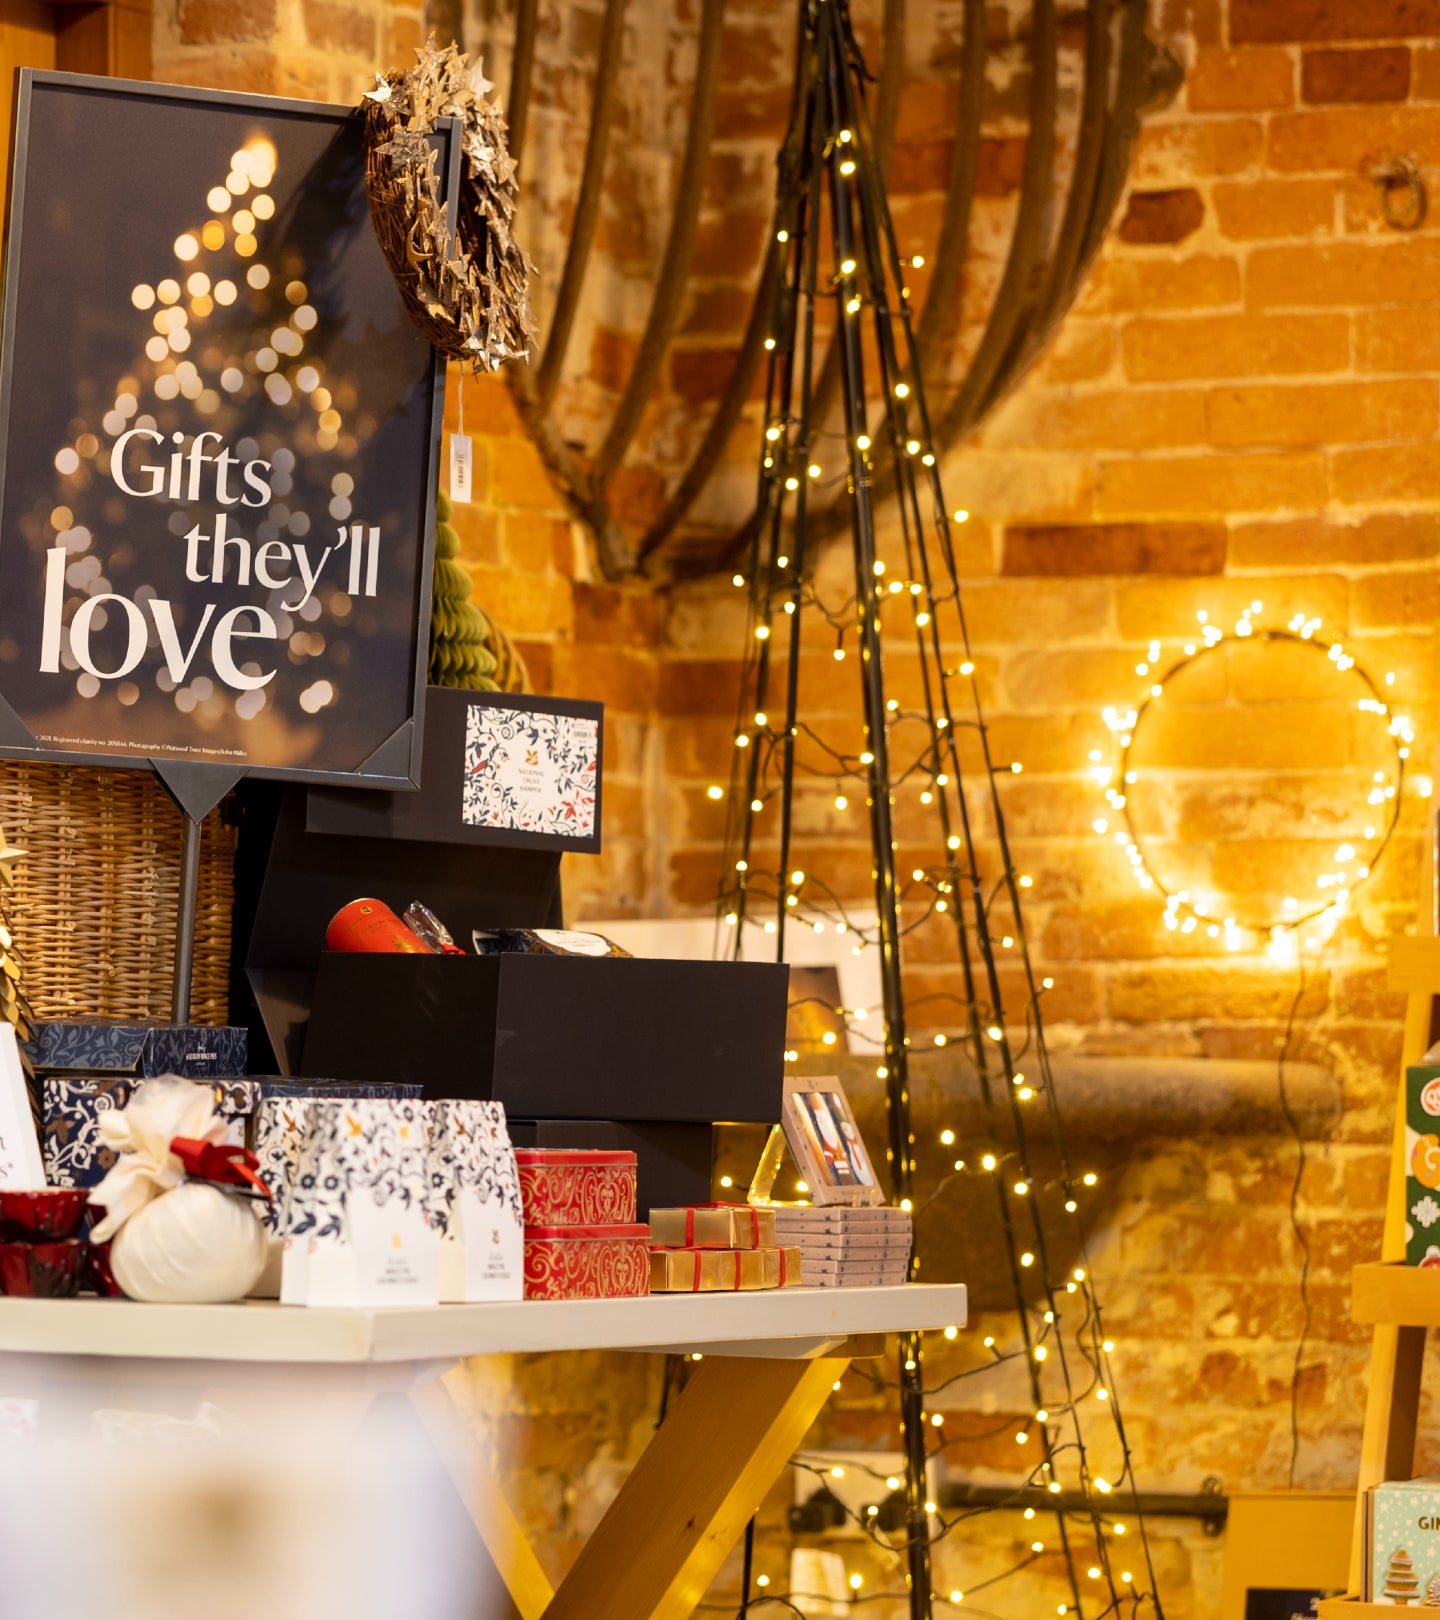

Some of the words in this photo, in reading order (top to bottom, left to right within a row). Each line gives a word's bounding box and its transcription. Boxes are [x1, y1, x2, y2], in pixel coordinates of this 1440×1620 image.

[111, 428, 272, 507] Gifts
[183, 513, 381, 612] they'll
[39, 547, 278, 690] love
[53, 735, 80, 745] Registered
[80, 738, 97, 746] charity
[128, 740, 160, 751] Photography
